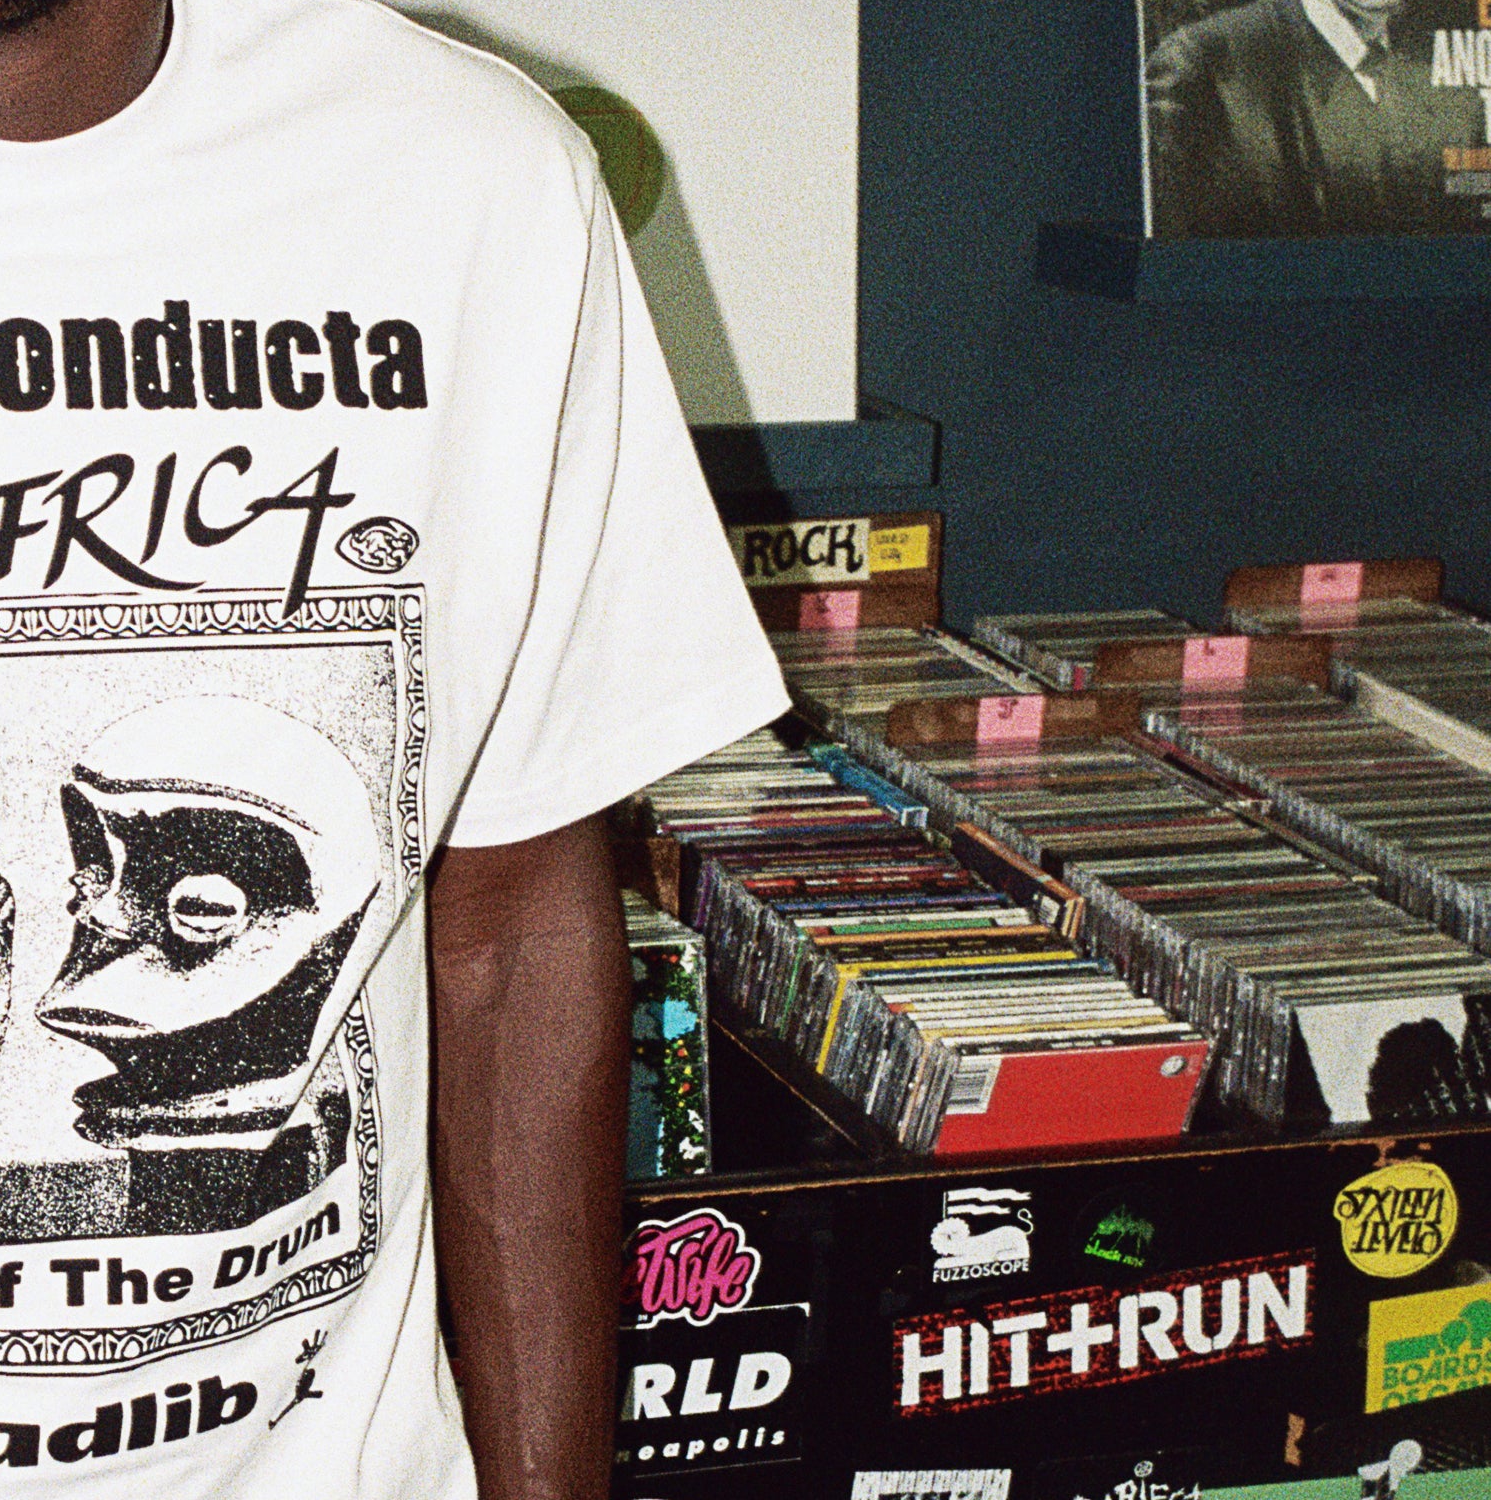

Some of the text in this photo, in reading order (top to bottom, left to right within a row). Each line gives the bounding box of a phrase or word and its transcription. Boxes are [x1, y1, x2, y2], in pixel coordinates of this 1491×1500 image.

[744, 523, 864, 577] ROCK
[50, 1257, 193, 1307] The
[212, 1197, 341, 1290] Drum
[932, 1258, 1029, 1283] FUZZOSCOPE
[634, 1352, 792, 1420] RLD
[637, 1428, 785, 1463] eapolis
